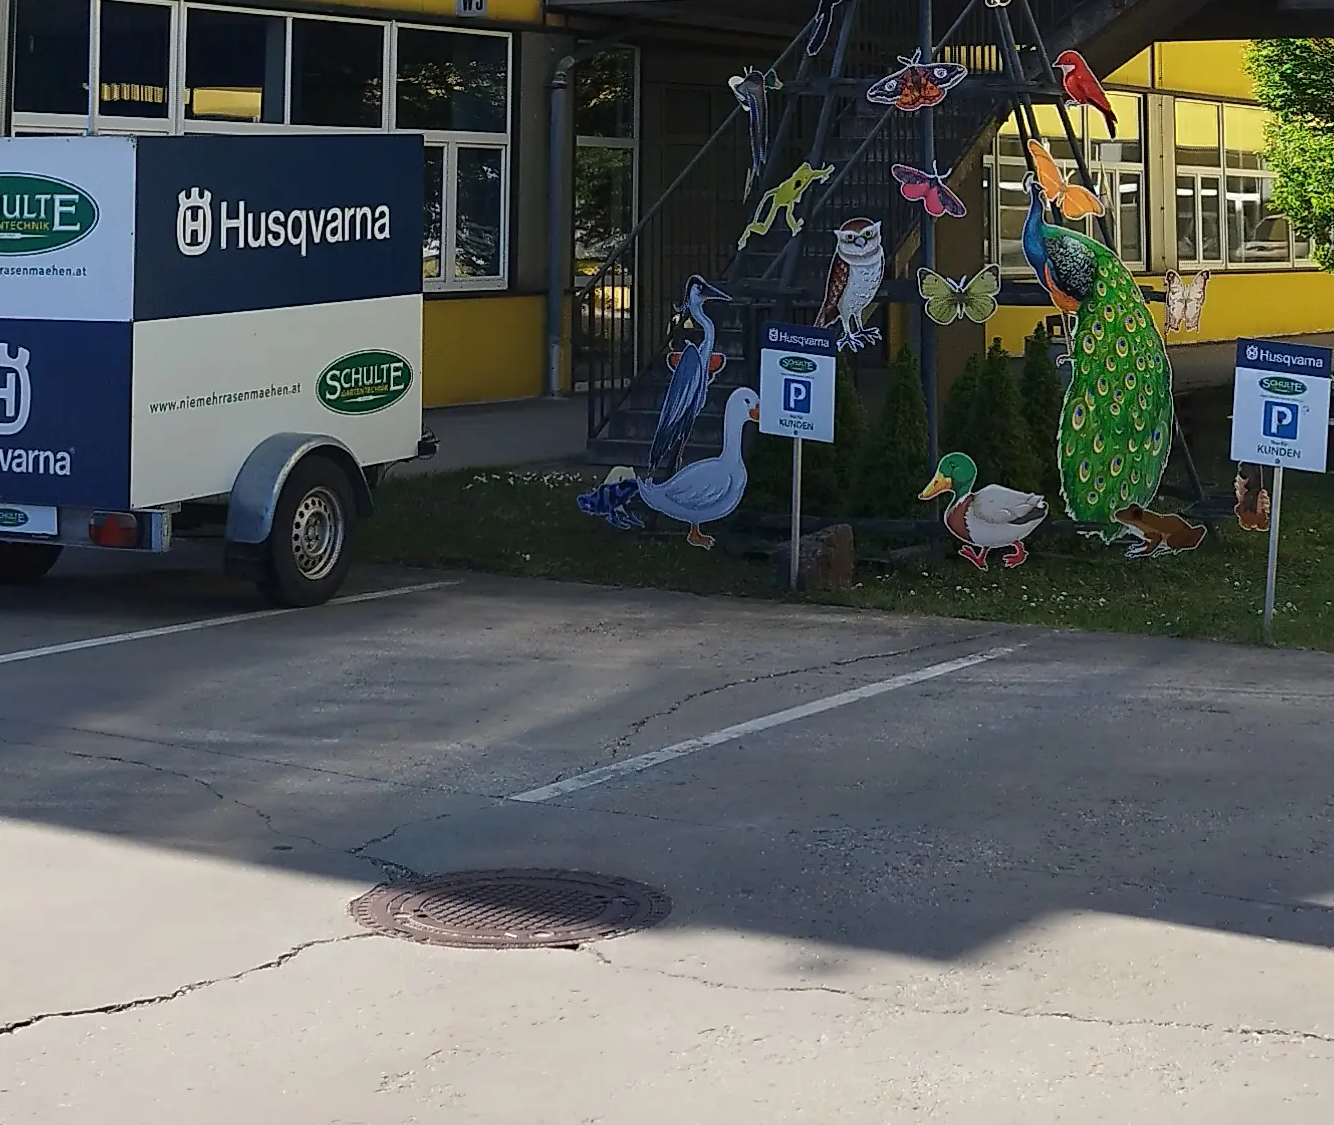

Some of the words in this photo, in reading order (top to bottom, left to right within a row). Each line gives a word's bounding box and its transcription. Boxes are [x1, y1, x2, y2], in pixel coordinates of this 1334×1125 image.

[220, 200, 391, 258] Husqvarna
[778, 331, 830, 348] Husqvarna
[1259, 348, 1324, 368] Husqvarna
[325, 361, 405, 400] SCHULTE
[149, 382, 302, 414] www.niemehrrasenmaehen.at
[789, 383, 807, 409] P
[779, 418, 814, 431] KUNDEN
[1270, 405, 1293, 434] P
[1256, 444, 1302, 459] KUNDEN
